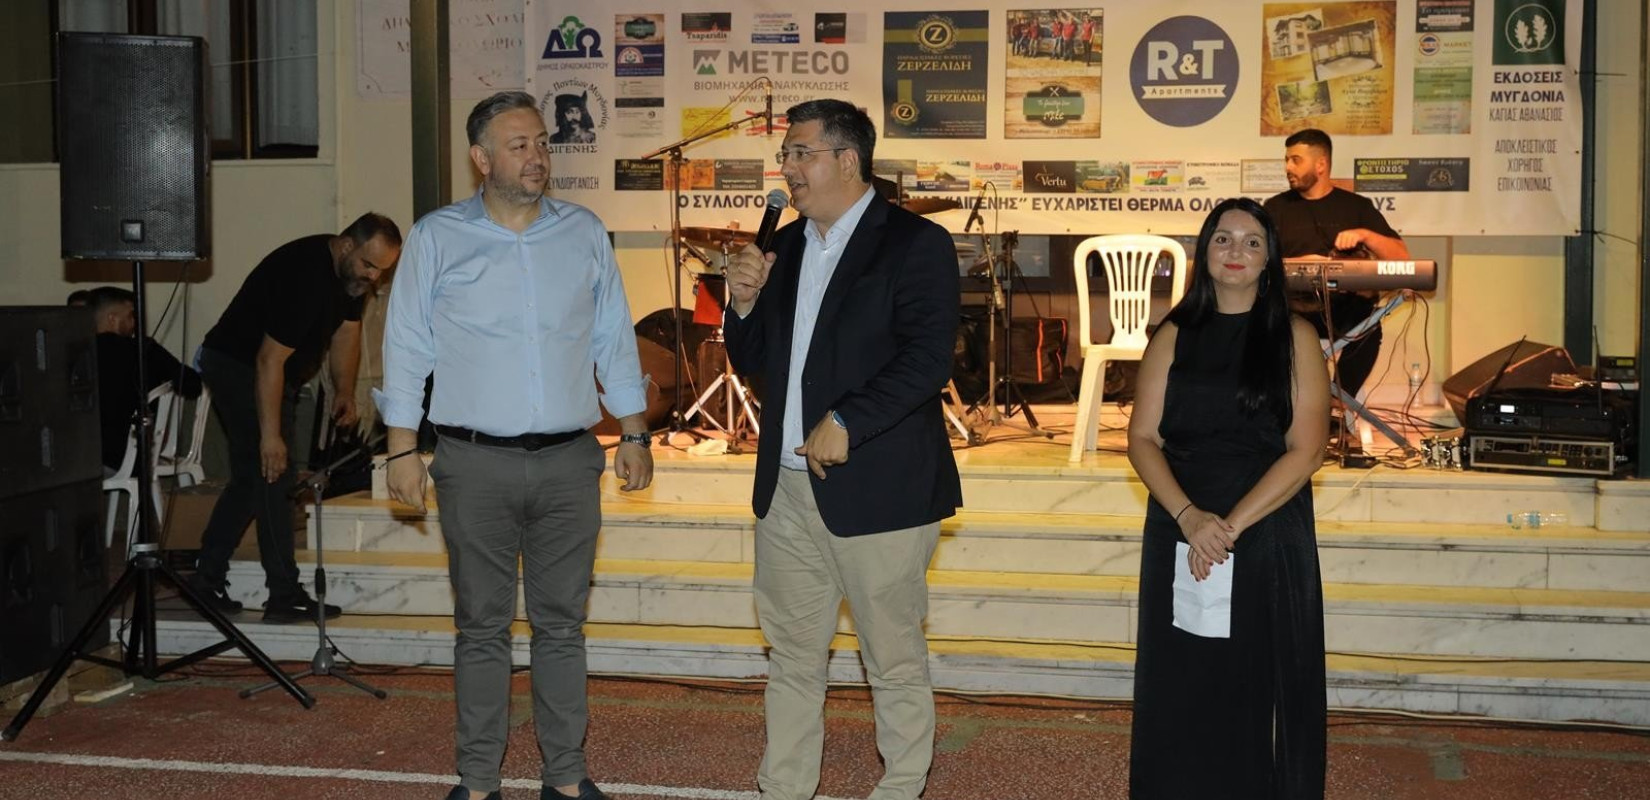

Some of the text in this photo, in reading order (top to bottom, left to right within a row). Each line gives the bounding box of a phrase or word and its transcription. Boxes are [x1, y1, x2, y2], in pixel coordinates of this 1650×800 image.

[930, 27, 943, 42] Z
[536, 62, 559, 71] ΔΗΜΟΣ
[560, 62, 608, 71] ΩΡΑΙΟΚΑΣΤΡΟΥ
[728, 50, 850, 75] METECO
[897, 61, 972, 71] ΖΕΡΖΕΛΙΔΗ
[1147, 40, 1224, 81] R&T
[1494, 71, 1563, 84] ΕΚΔΟΣΕΙΣ
[694, 81, 764, 91] ΒΙΟΜΗΧΑΝΙΑ
[1151, 88, 1218, 96] Apartments
[925, 94, 985, 102] ΖΕΡΖΕΛΙΔΗ
[1490, 90, 1565, 103] ΜΥΓΔΟΝΙΑ
[901, 107, 910, 117] Z
[1519, 107, 1564, 122] ΑΘΑΝΑΣΙΟΣ
[548, 145, 598, 154] ΔΙΓΕΝΗΣ
[1494, 139, 1558, 154] ΑΠΟΚΛΕΙΣΤΙΚΟΣ
[1507, 158, 1543, 173] ΧΟΡΗΓΟΣ
[1041, 176, 1067, 187] Vertu
[1497, 177, 1553, 192] ΕΠΙΚΟΙΝΩΝΙΑΣ
[693, 195, 767, 209] ΣΥΛΛΟΓΟ
[1032, 197, 1122, 211] ΕΥΧΑΡΙΣΤΕΙ
[1127, 198, 1185, 212] ΘΕΡΜΑ
[1377, 261, 1415, 275] KORG
